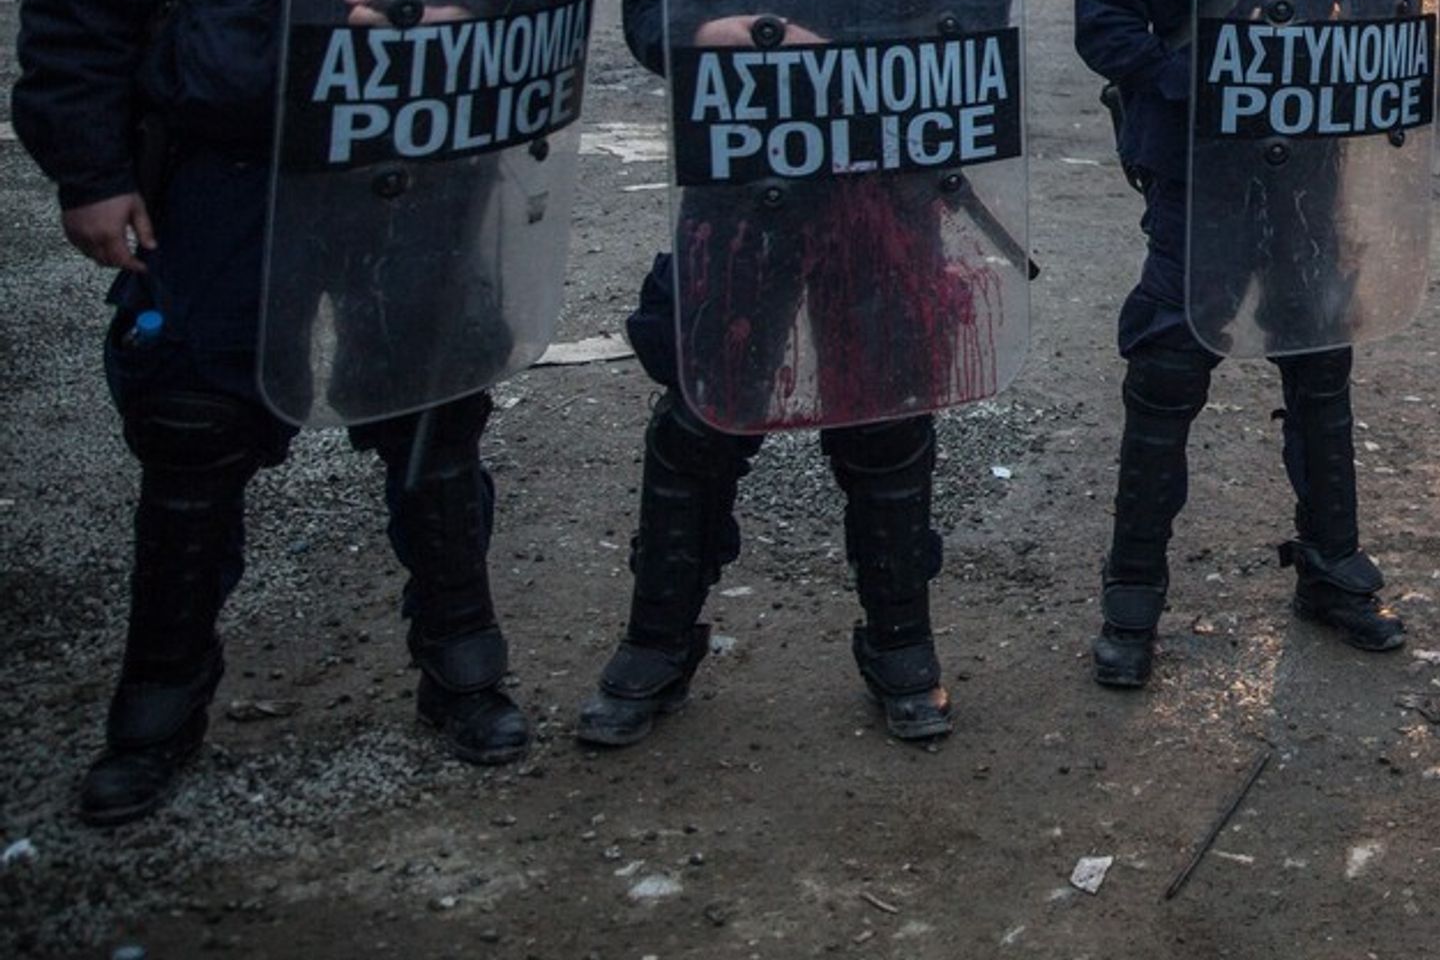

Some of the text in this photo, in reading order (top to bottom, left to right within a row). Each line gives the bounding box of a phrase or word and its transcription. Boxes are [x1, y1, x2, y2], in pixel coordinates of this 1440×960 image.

[312, 0, 586, 101] ΑΣΤΥΝΟΜΙΑ
[691, 36, 1008, 121] ΑΣΤΥΝΟΜΙΑ
[1208, 20, 1429, 84] ΑΣΤΥΝΟΜΙΑ
[328, 68, 577, 163] POLICE
[709, 104, 997, 179] POLICE
[1221, 77, 1422, 134] POLICE
